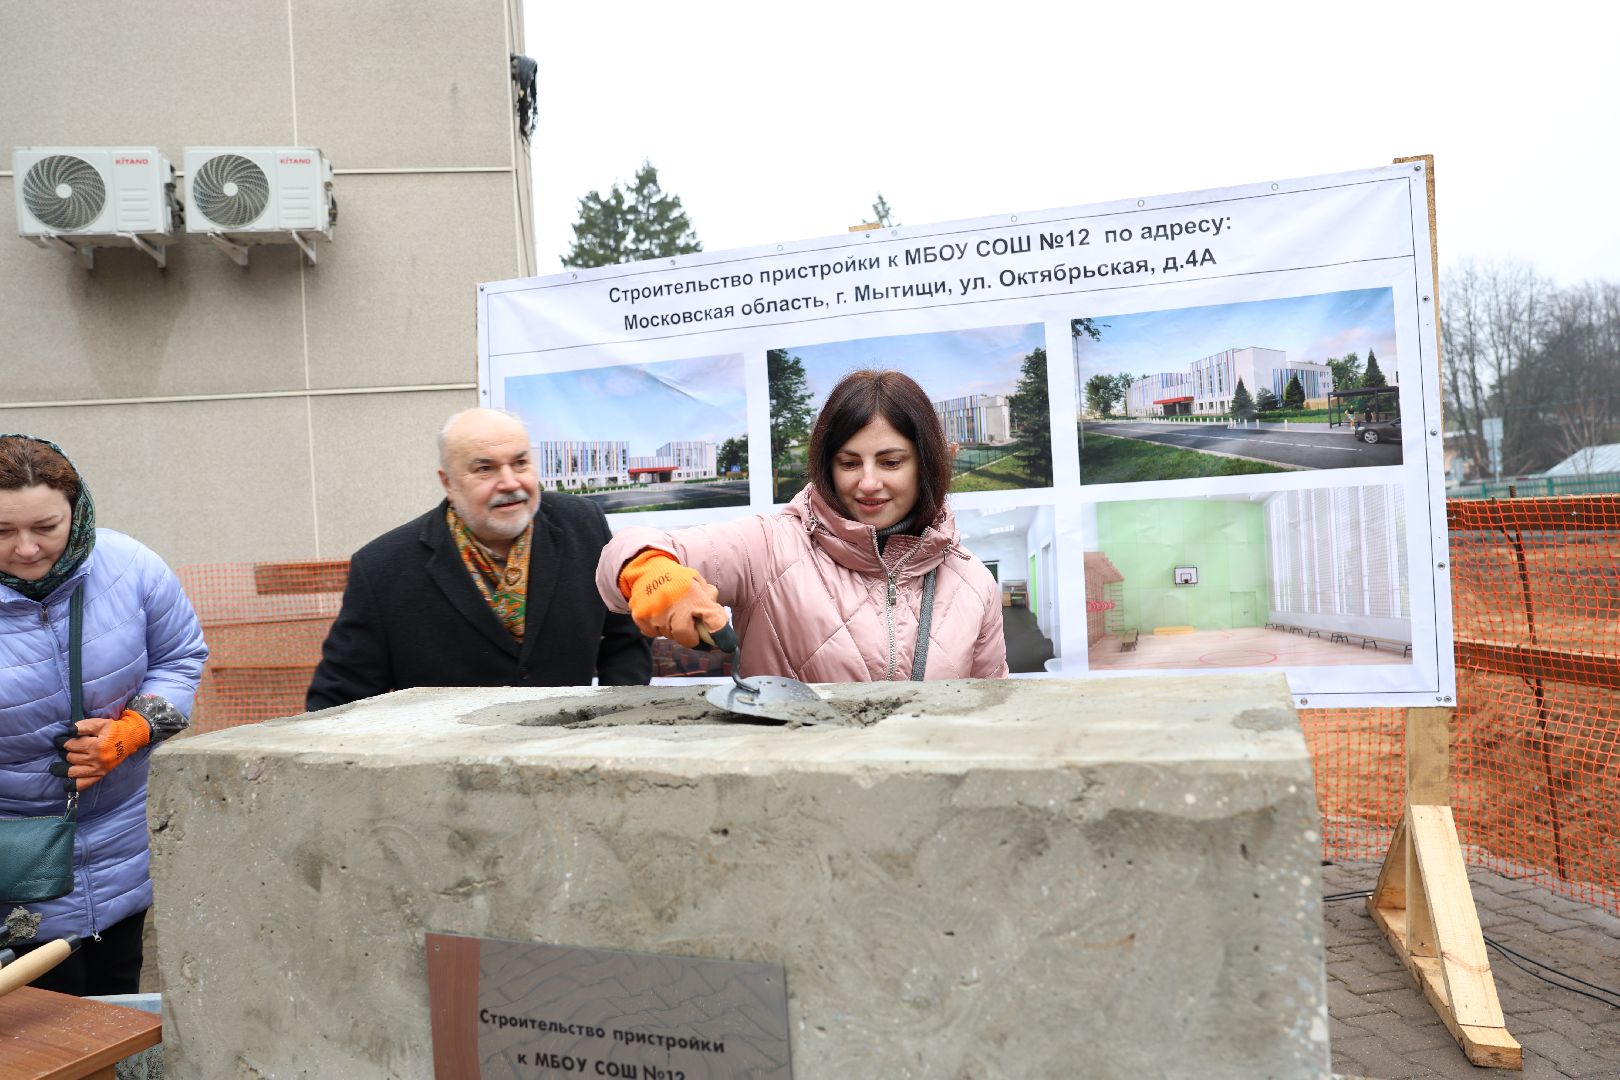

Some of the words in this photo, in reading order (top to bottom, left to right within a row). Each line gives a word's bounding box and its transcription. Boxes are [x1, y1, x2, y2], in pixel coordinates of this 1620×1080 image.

[609, 271, 753, 304] Строительство
[760, 255, 880, 286] пристройки
[888, 256, 898, 268] к
[905, 243, 968, 265] МБОУ
[976, 235, 1031, 257] СОШ
[1040, 228, 1090, 250] №12
[1105, 228, 1133, 244] по
[1140, 215, 1231, 241] адресу:
[624, 303, 734, 330] Московская
[742, 295, 829, 316] область,
[836, 292, 847, 304] г.
[855, 281, 952, 303] Мытищи,
[960, 274, 992, 295] ул.
[999, 257, 1155, 288] Октябрьская,
[1162, 248, 1217, 273] д.4А
[480, 1008, 605, 1039] Строительство
[613, 1029, 725, 1053] пристройки
[518, 1053, 528, 1064] к
[535, 1052, 587, 1072] МБОУ
[595, 1060, 637, 1079] СОШ
